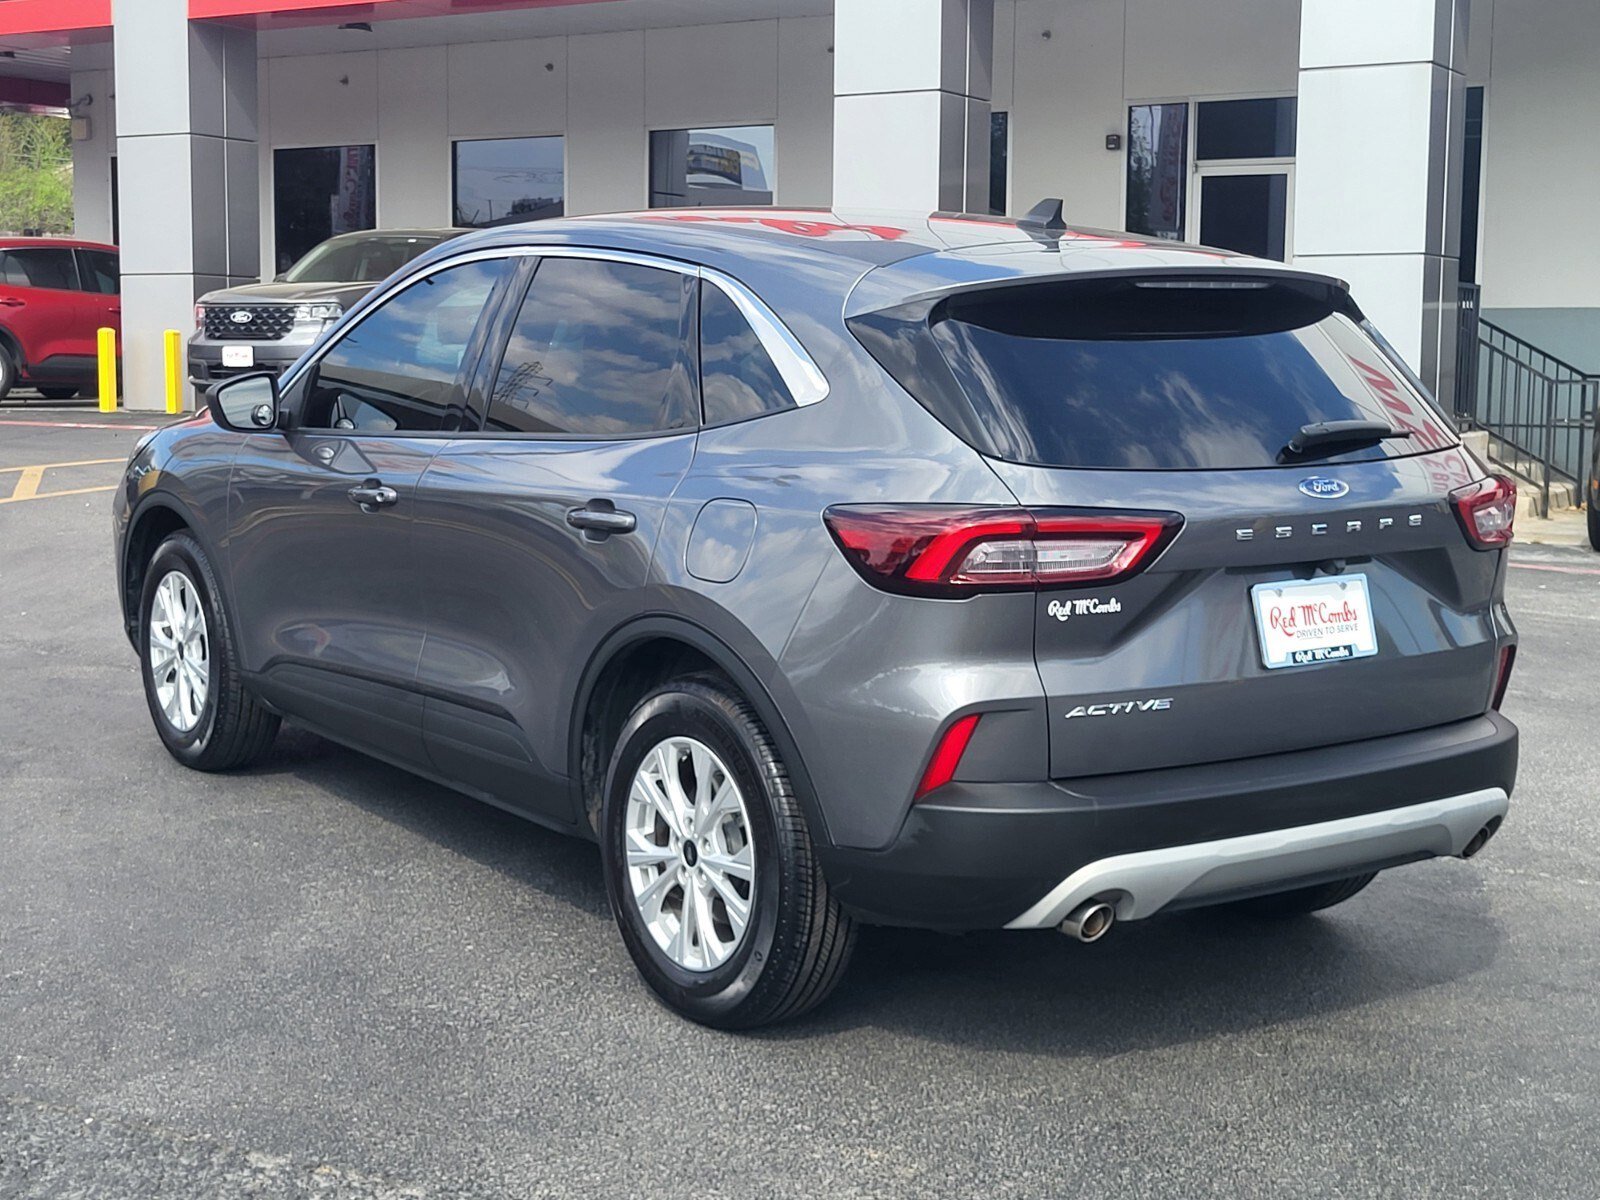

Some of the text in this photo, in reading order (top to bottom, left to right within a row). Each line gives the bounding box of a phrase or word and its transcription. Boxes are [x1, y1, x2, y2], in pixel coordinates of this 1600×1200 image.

[1235, 514, 1423, 541] ESCAPE
[1047, 600, 1073, 622] Red
[1270, 601, 1357, 637] Red McCombs
[1296, 623, 1359, 638] DRIVEN TO SERVE
[1064, 697, 1174, 719] ACTIVE
